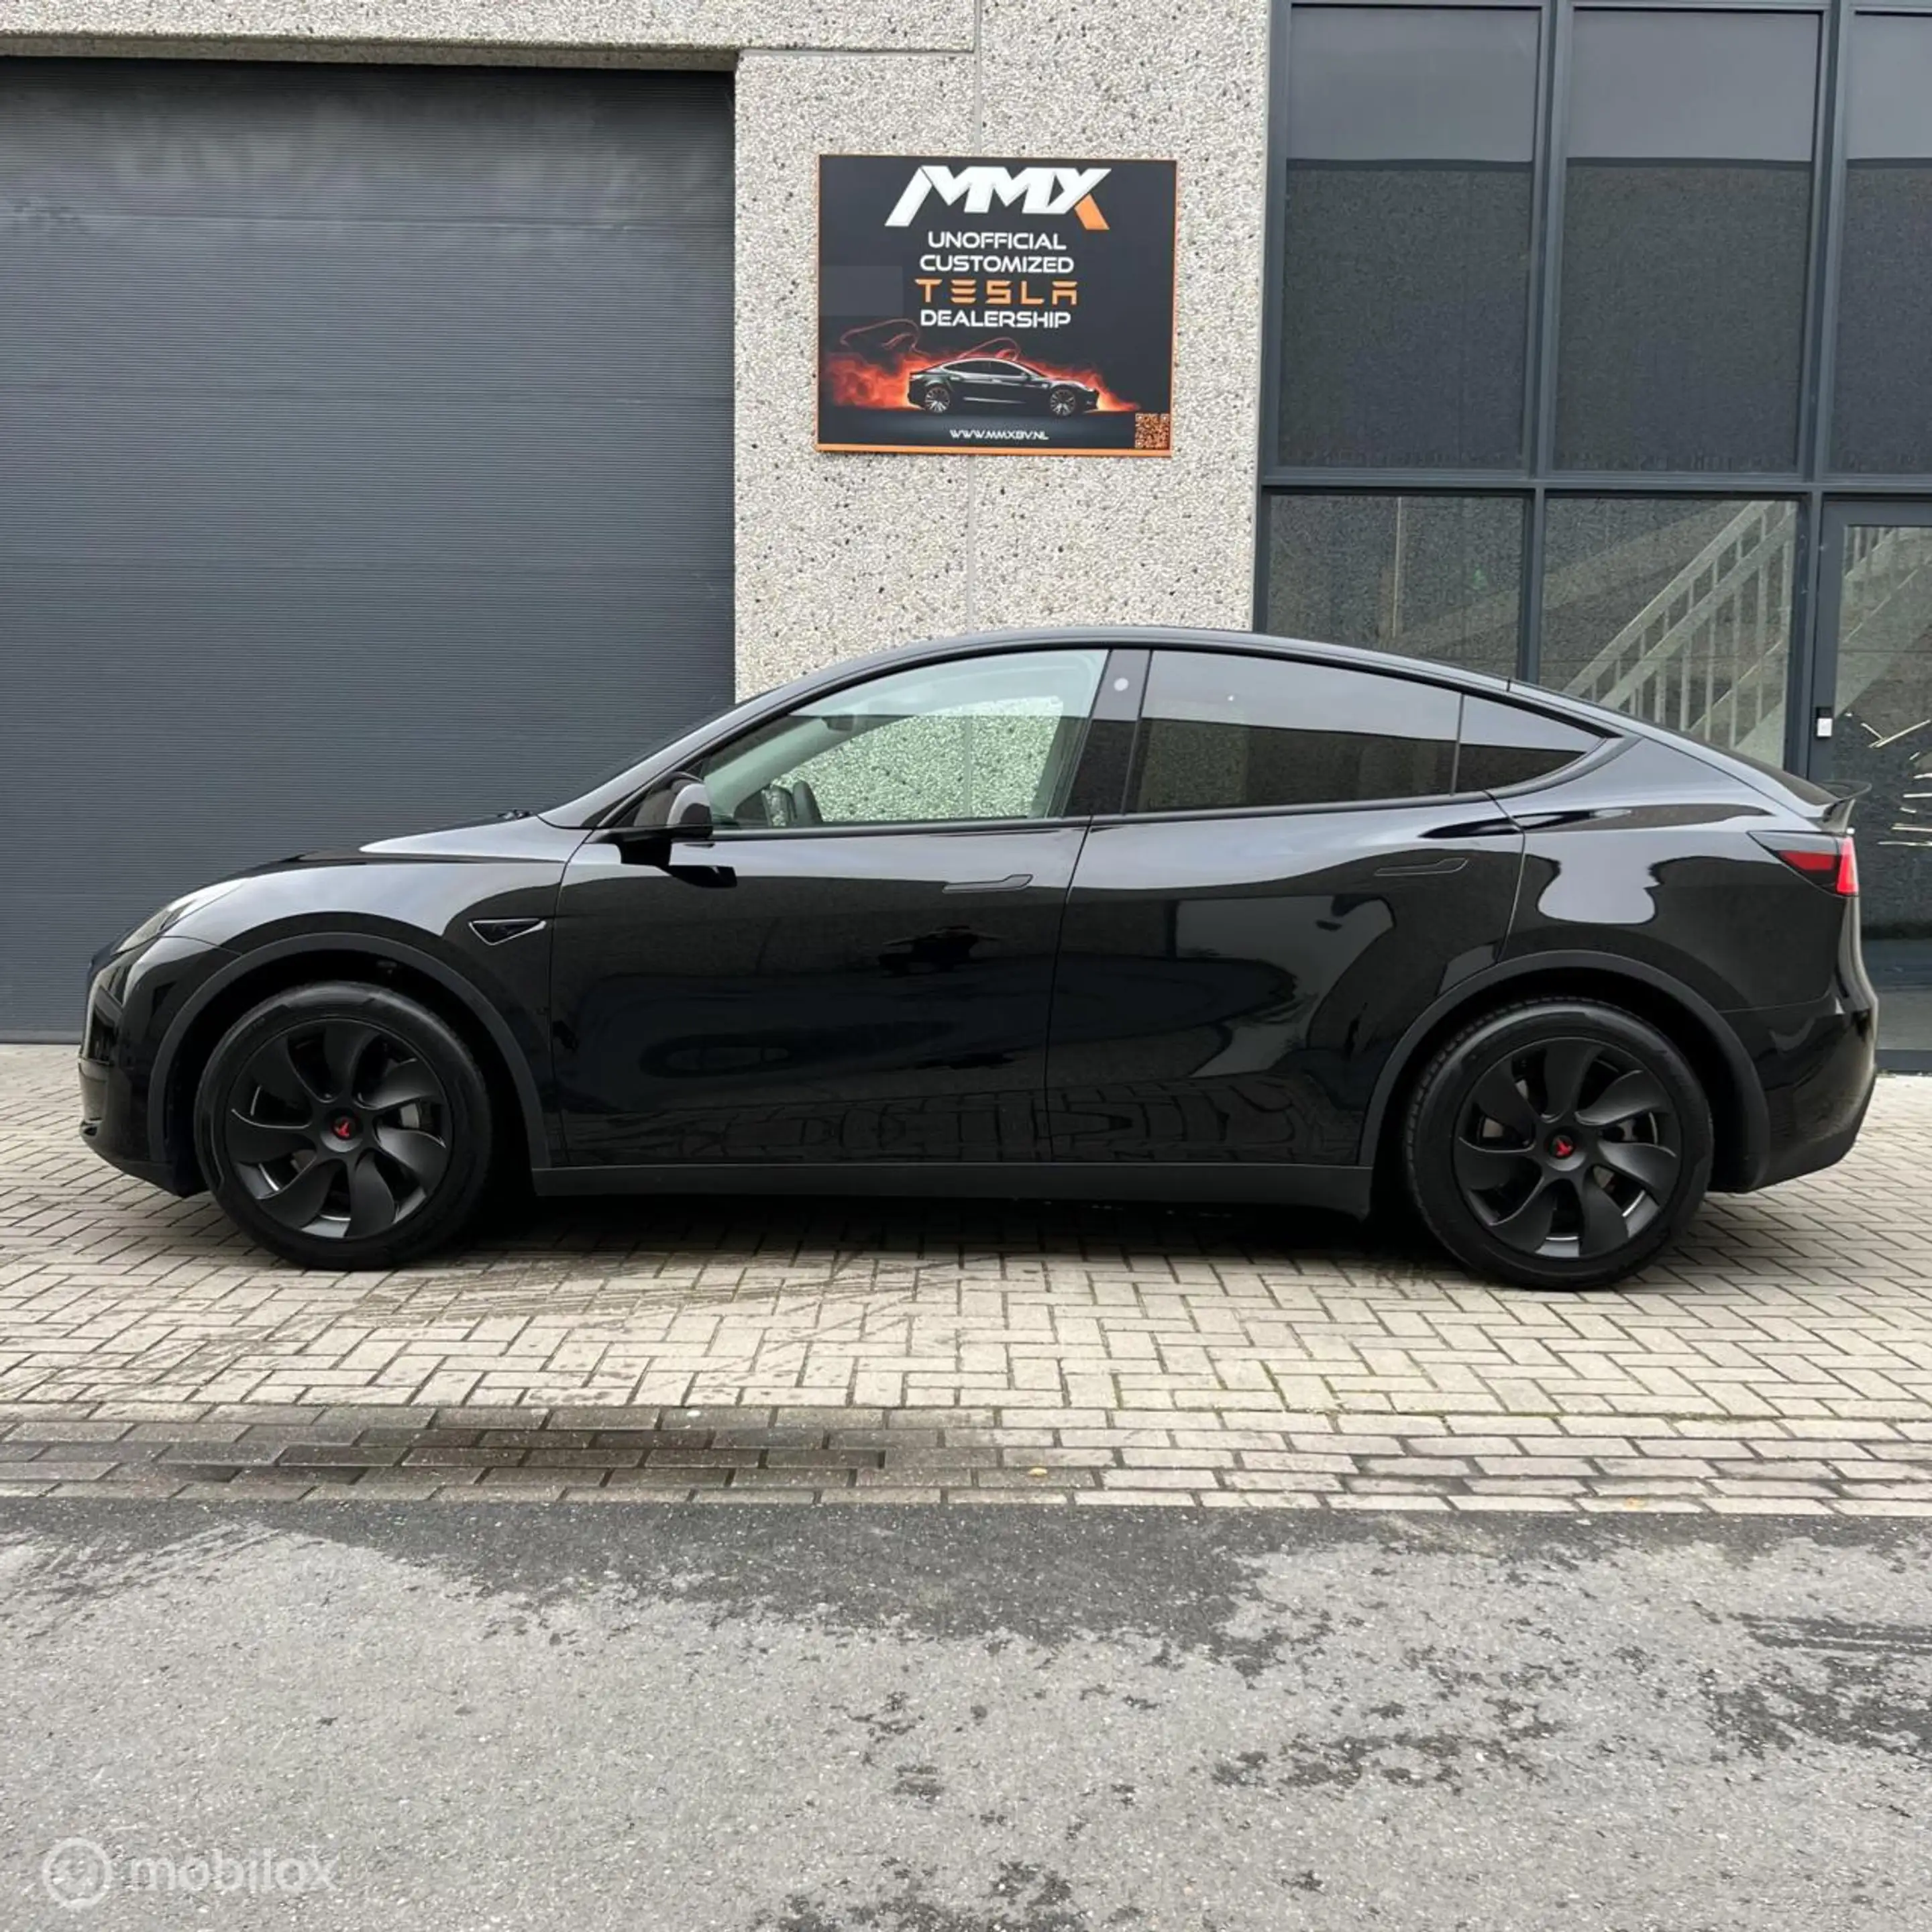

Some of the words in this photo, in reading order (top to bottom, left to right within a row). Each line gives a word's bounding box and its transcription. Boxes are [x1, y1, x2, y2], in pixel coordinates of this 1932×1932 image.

[885, 165, 1112, 229] MMX
[928, 231, 1067, 250] UNOFFICIAL
[920, 255, 1074, 273] CUSTOMIZED
[915, 278, 1077, 305] TESLA
[920, 310, 1071, 327] DEALERSHIP
